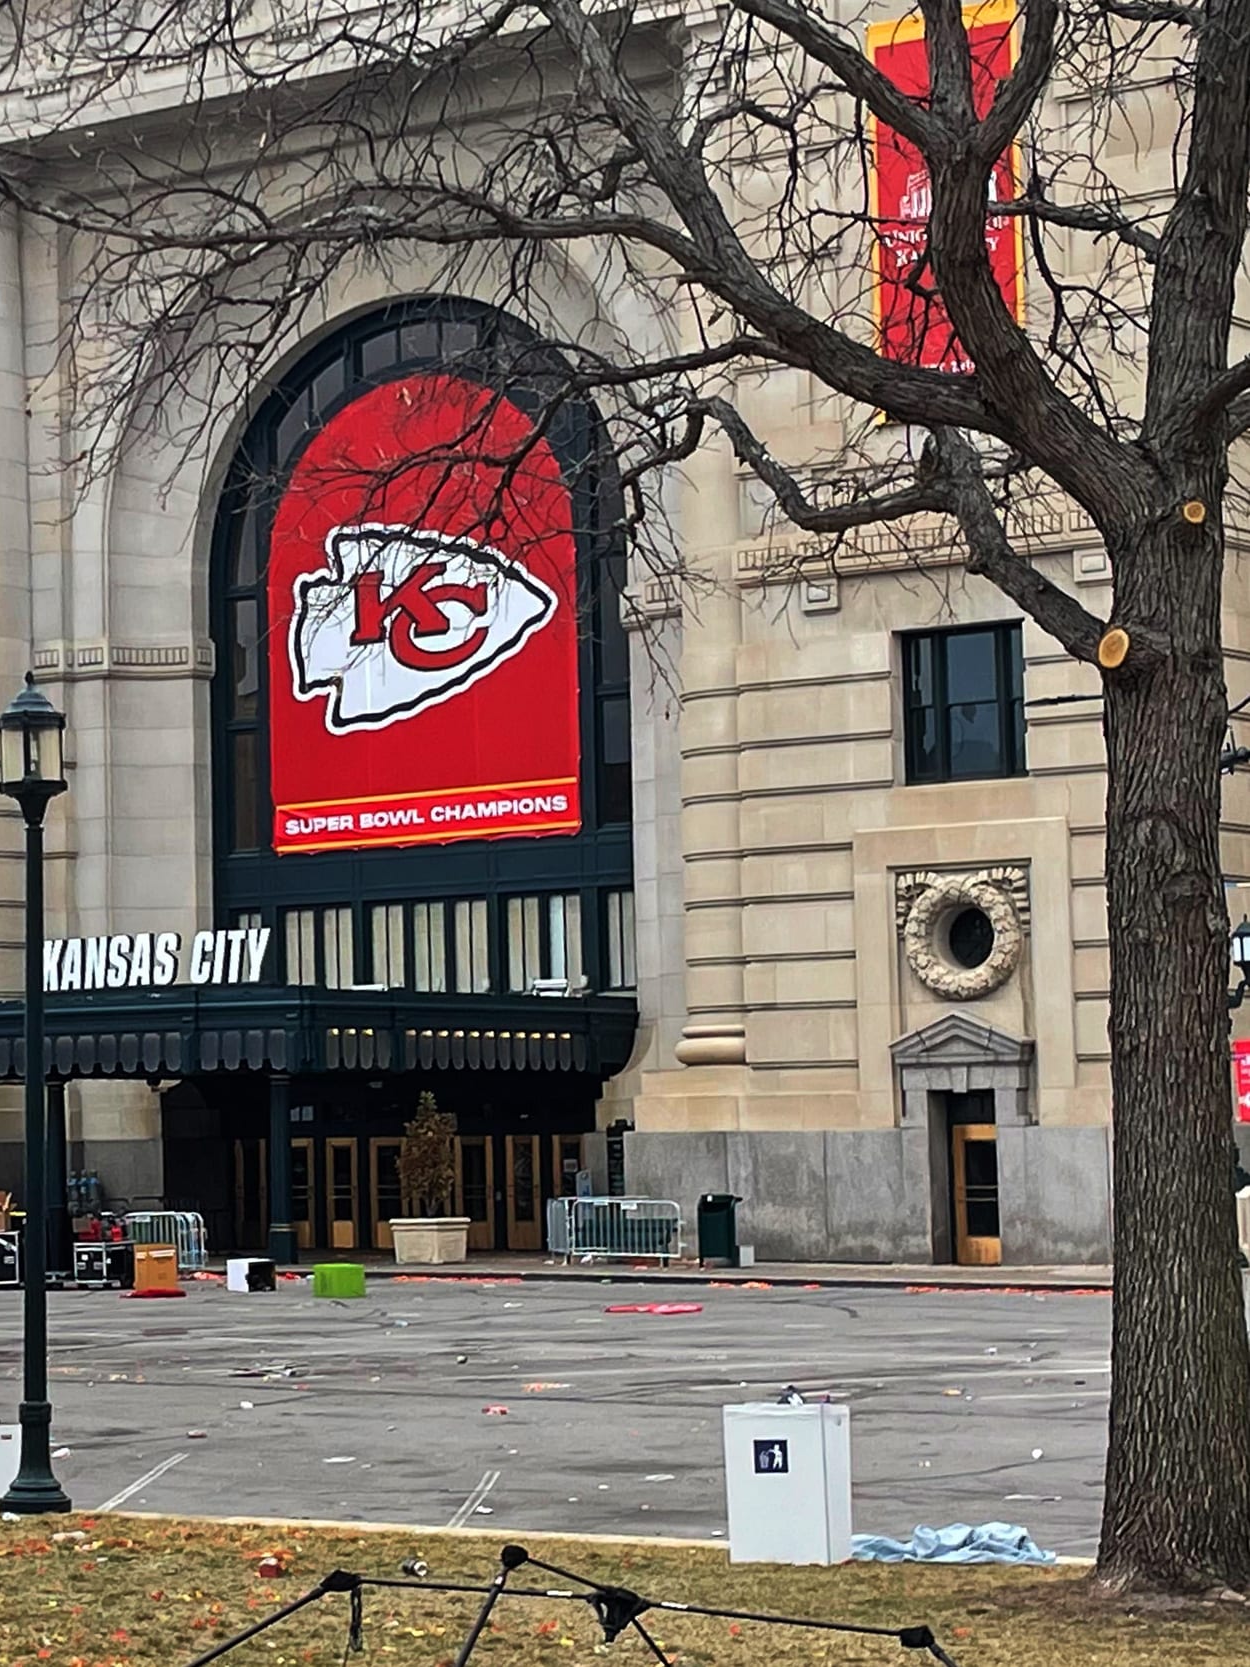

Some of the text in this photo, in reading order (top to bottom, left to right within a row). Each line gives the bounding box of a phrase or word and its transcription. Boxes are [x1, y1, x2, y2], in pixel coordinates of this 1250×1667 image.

[350, 562, 489, 672] KC
[285, 795, 568, 835] SUPER BOWL CHAMPIONS
[43, 928, 271, 992] KANSAS CITY
